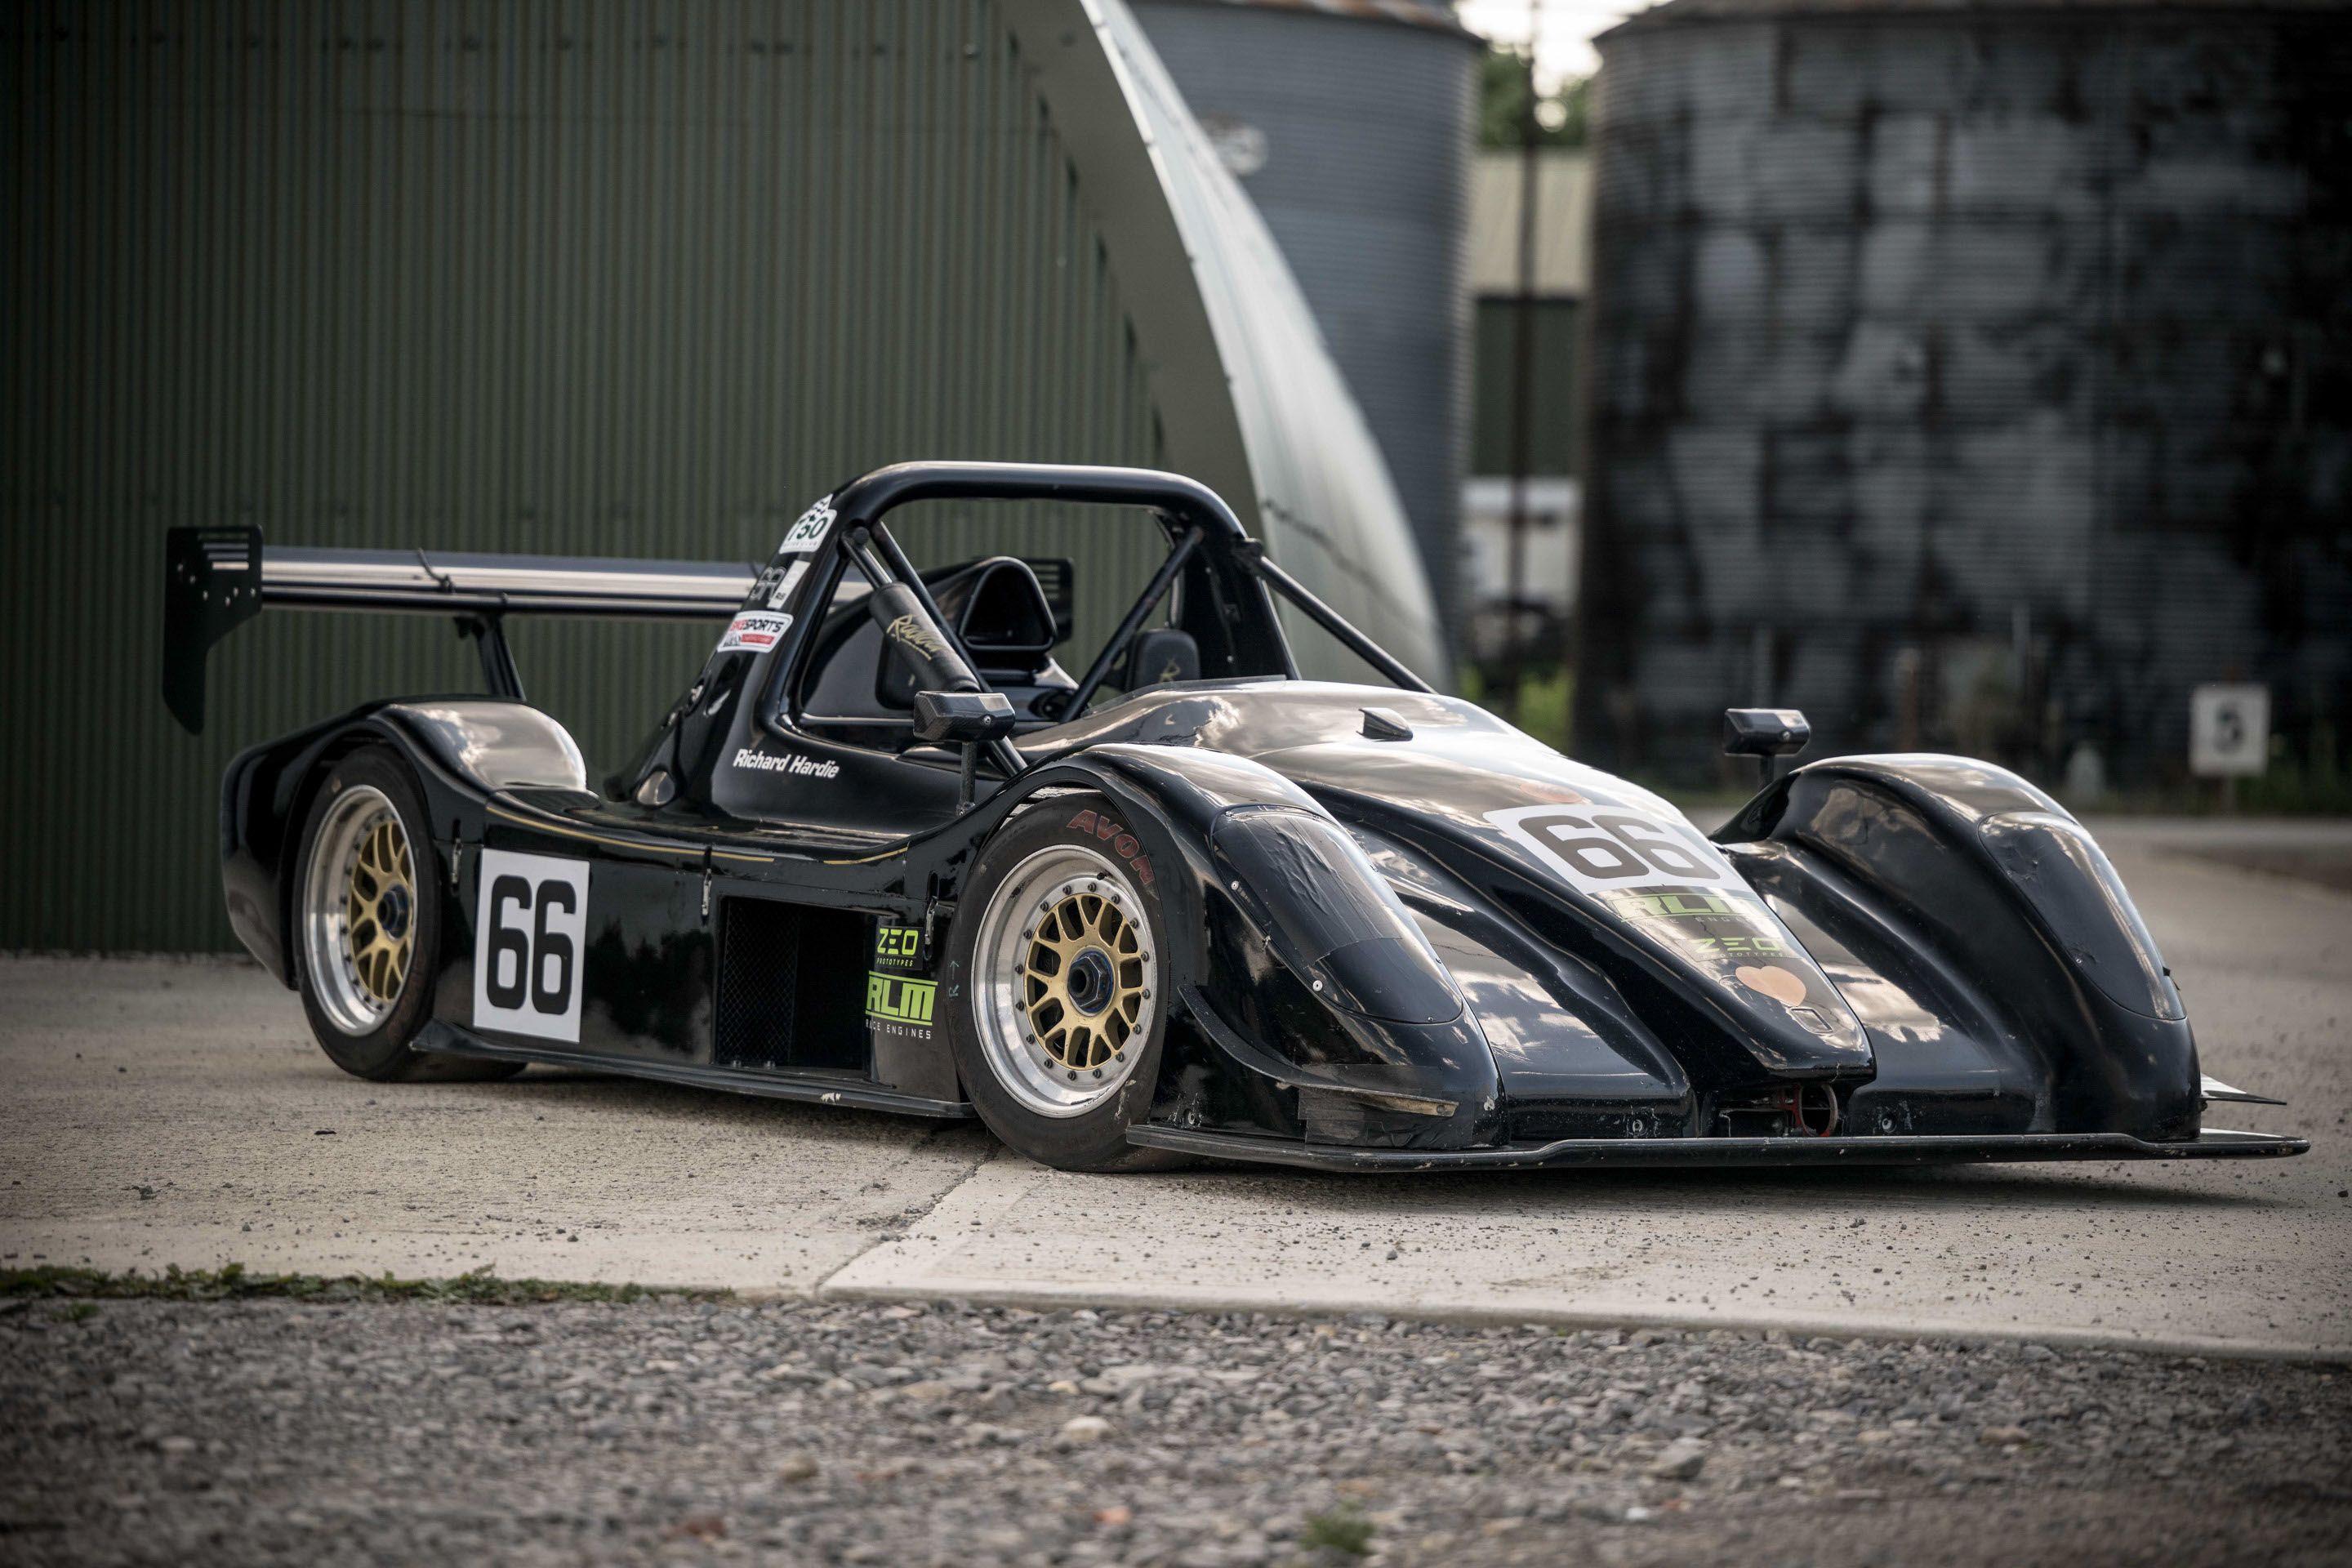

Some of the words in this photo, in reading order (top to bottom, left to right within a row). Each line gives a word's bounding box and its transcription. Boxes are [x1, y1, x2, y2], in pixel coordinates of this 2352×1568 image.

[733, 748, 792, 772] Richard
[788, 755, 840, 779] Hardie
[1066, 809, 1156, 884] AVON
[1518, 814, 1721, 880] 66
[486, 873, 577, 1016] 66
[876, 957, 914, 967] PROTOTYPES
[866, 975, 936, 1021] RLM
[886, 1023, 932, 1040] ENGINES
